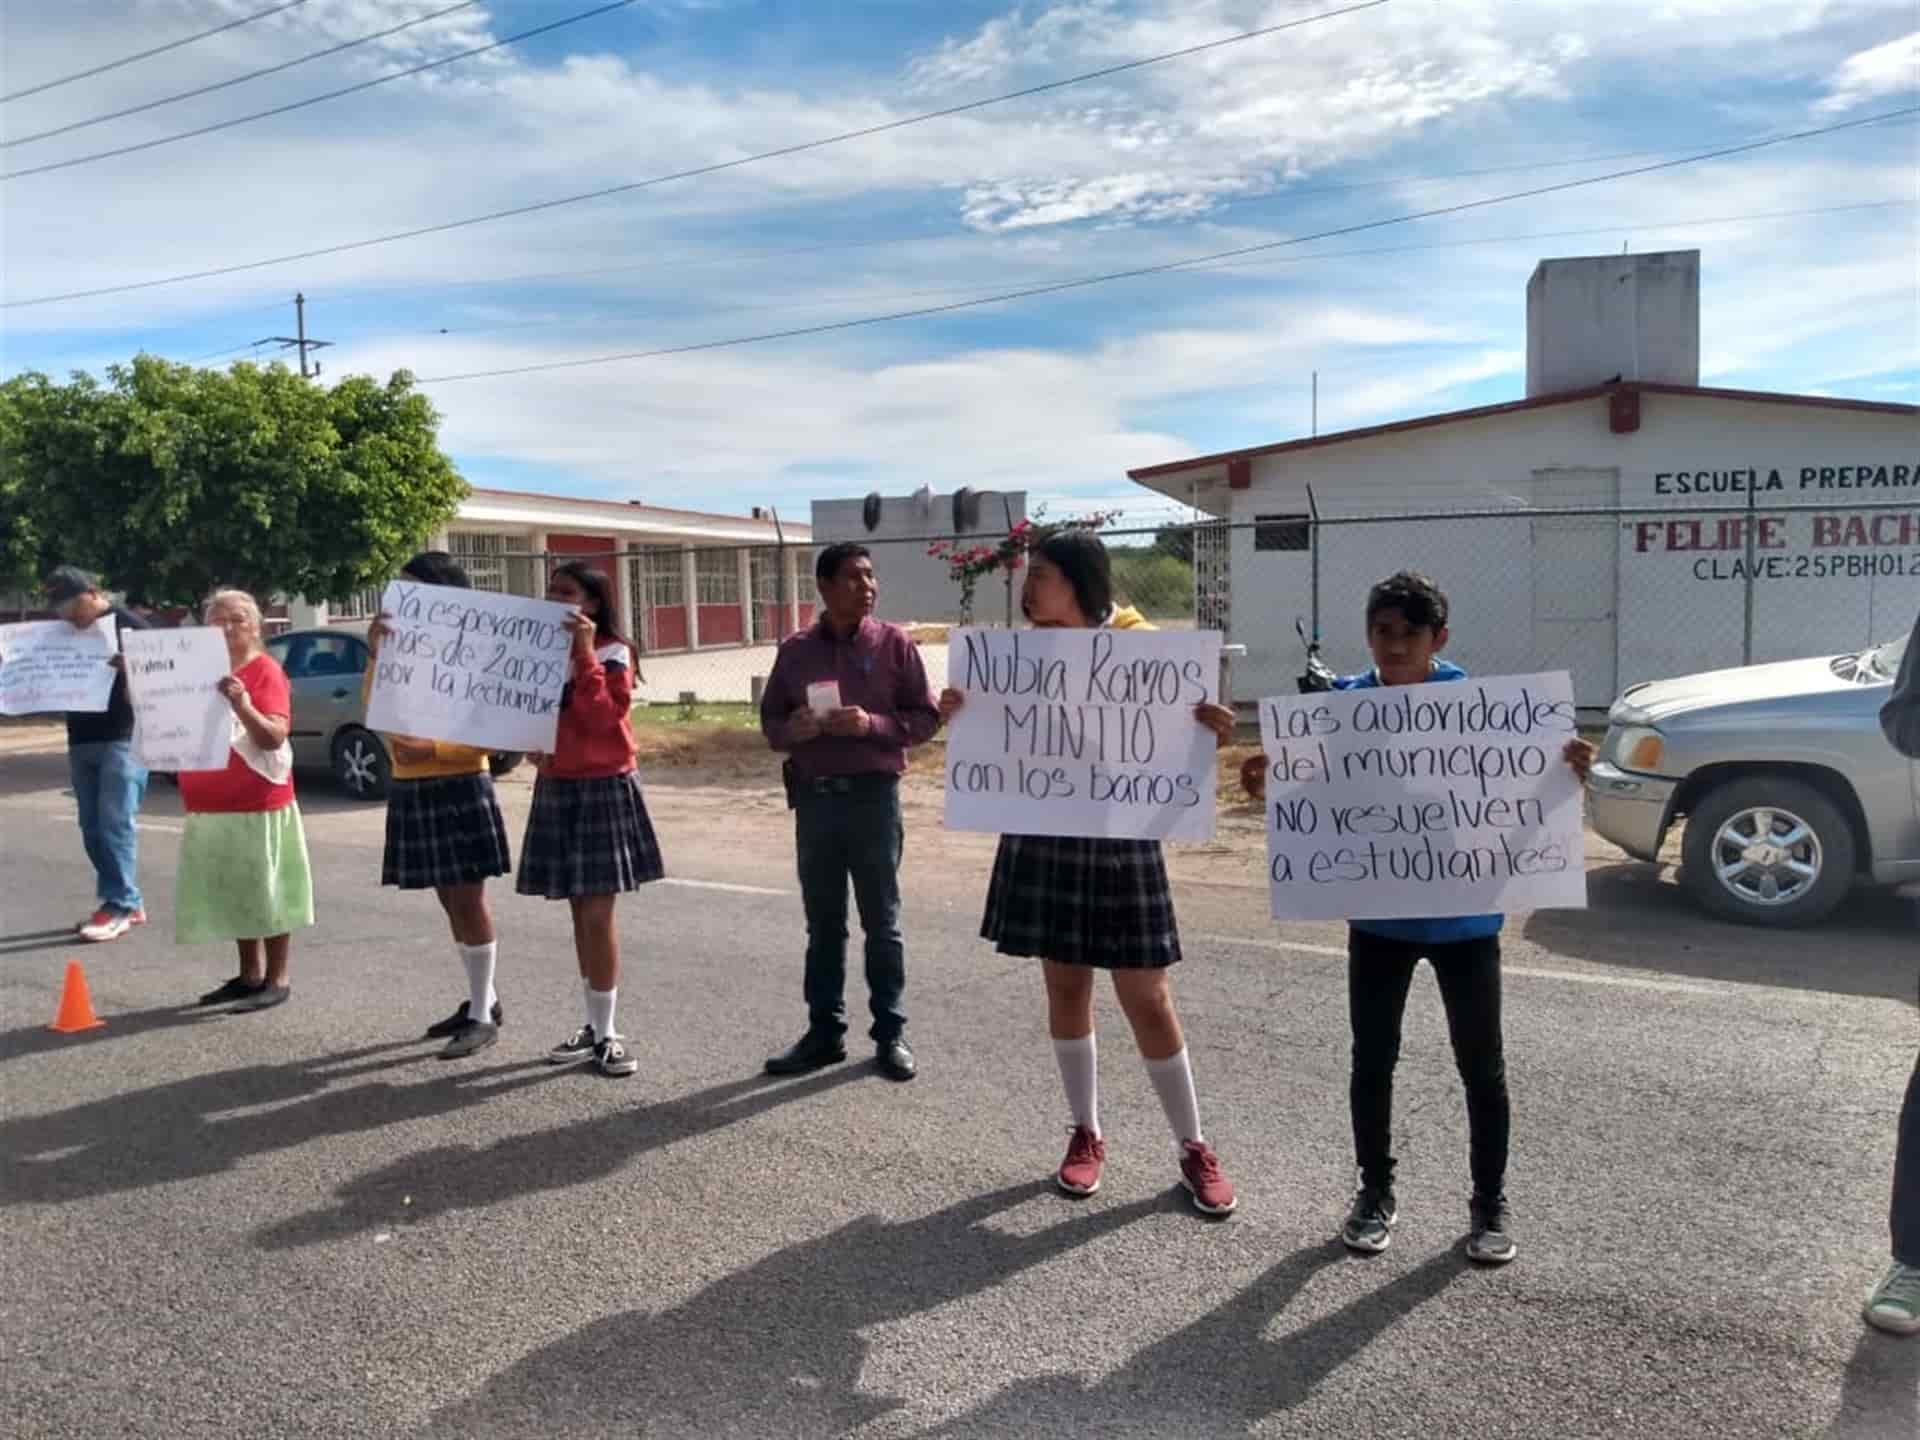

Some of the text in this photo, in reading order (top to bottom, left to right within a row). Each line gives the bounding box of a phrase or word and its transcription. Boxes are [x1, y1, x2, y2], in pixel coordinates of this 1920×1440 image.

[1655, 469, 1784, 494] ESCUELA
[1811, 513, 1920, 548] BACH
[396, 583, 421, 618] Ya
[441, 629, 475, 668] de
[376, 661, 414, 689] por
[431, 663, 455, 697] la
[964, 630, 1208, 706] Nubia Ramos
[1271, 703, 1342, 740] Las
[951, 760, 1004, 793] con
[1018, 759, 1076, 800] los
[1272, 743, 1547, 797] del municipio
[1275, 789, 1546, 836] NO resuelven
[1271, 852, 1294, 883] a
